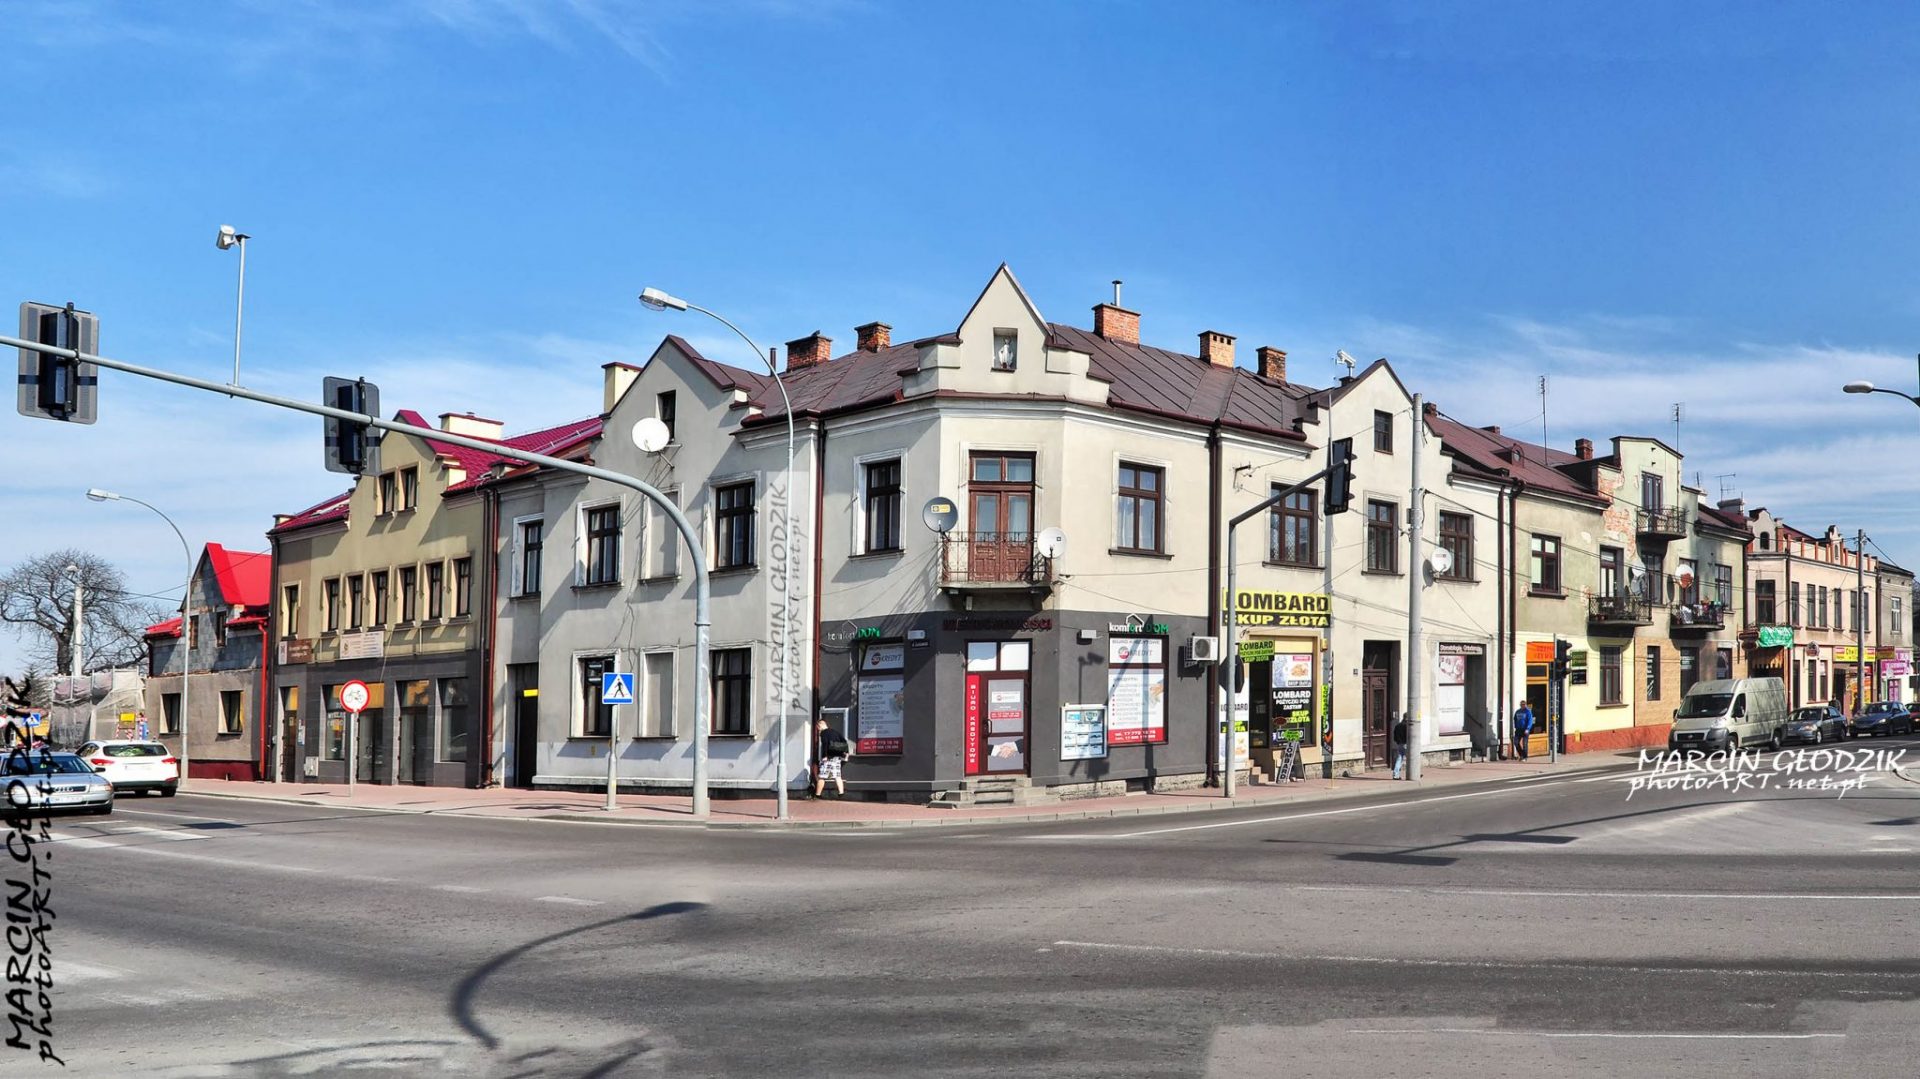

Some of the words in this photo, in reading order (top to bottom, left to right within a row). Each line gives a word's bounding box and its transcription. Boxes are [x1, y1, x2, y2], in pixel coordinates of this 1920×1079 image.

[1278, 615, 1329, 626] ZŁOTA
[857, 625, 881, 640] DOM
[1108, 621, 1144, 633] komfort
[1239, 640, 1274, 651] LOMBARD
[1273, 690, 1311, 700] LOMBARD
[969, 716, 977, 763] KREDYTOWE
[1280, 742, 1294, 780] LOMBARD
